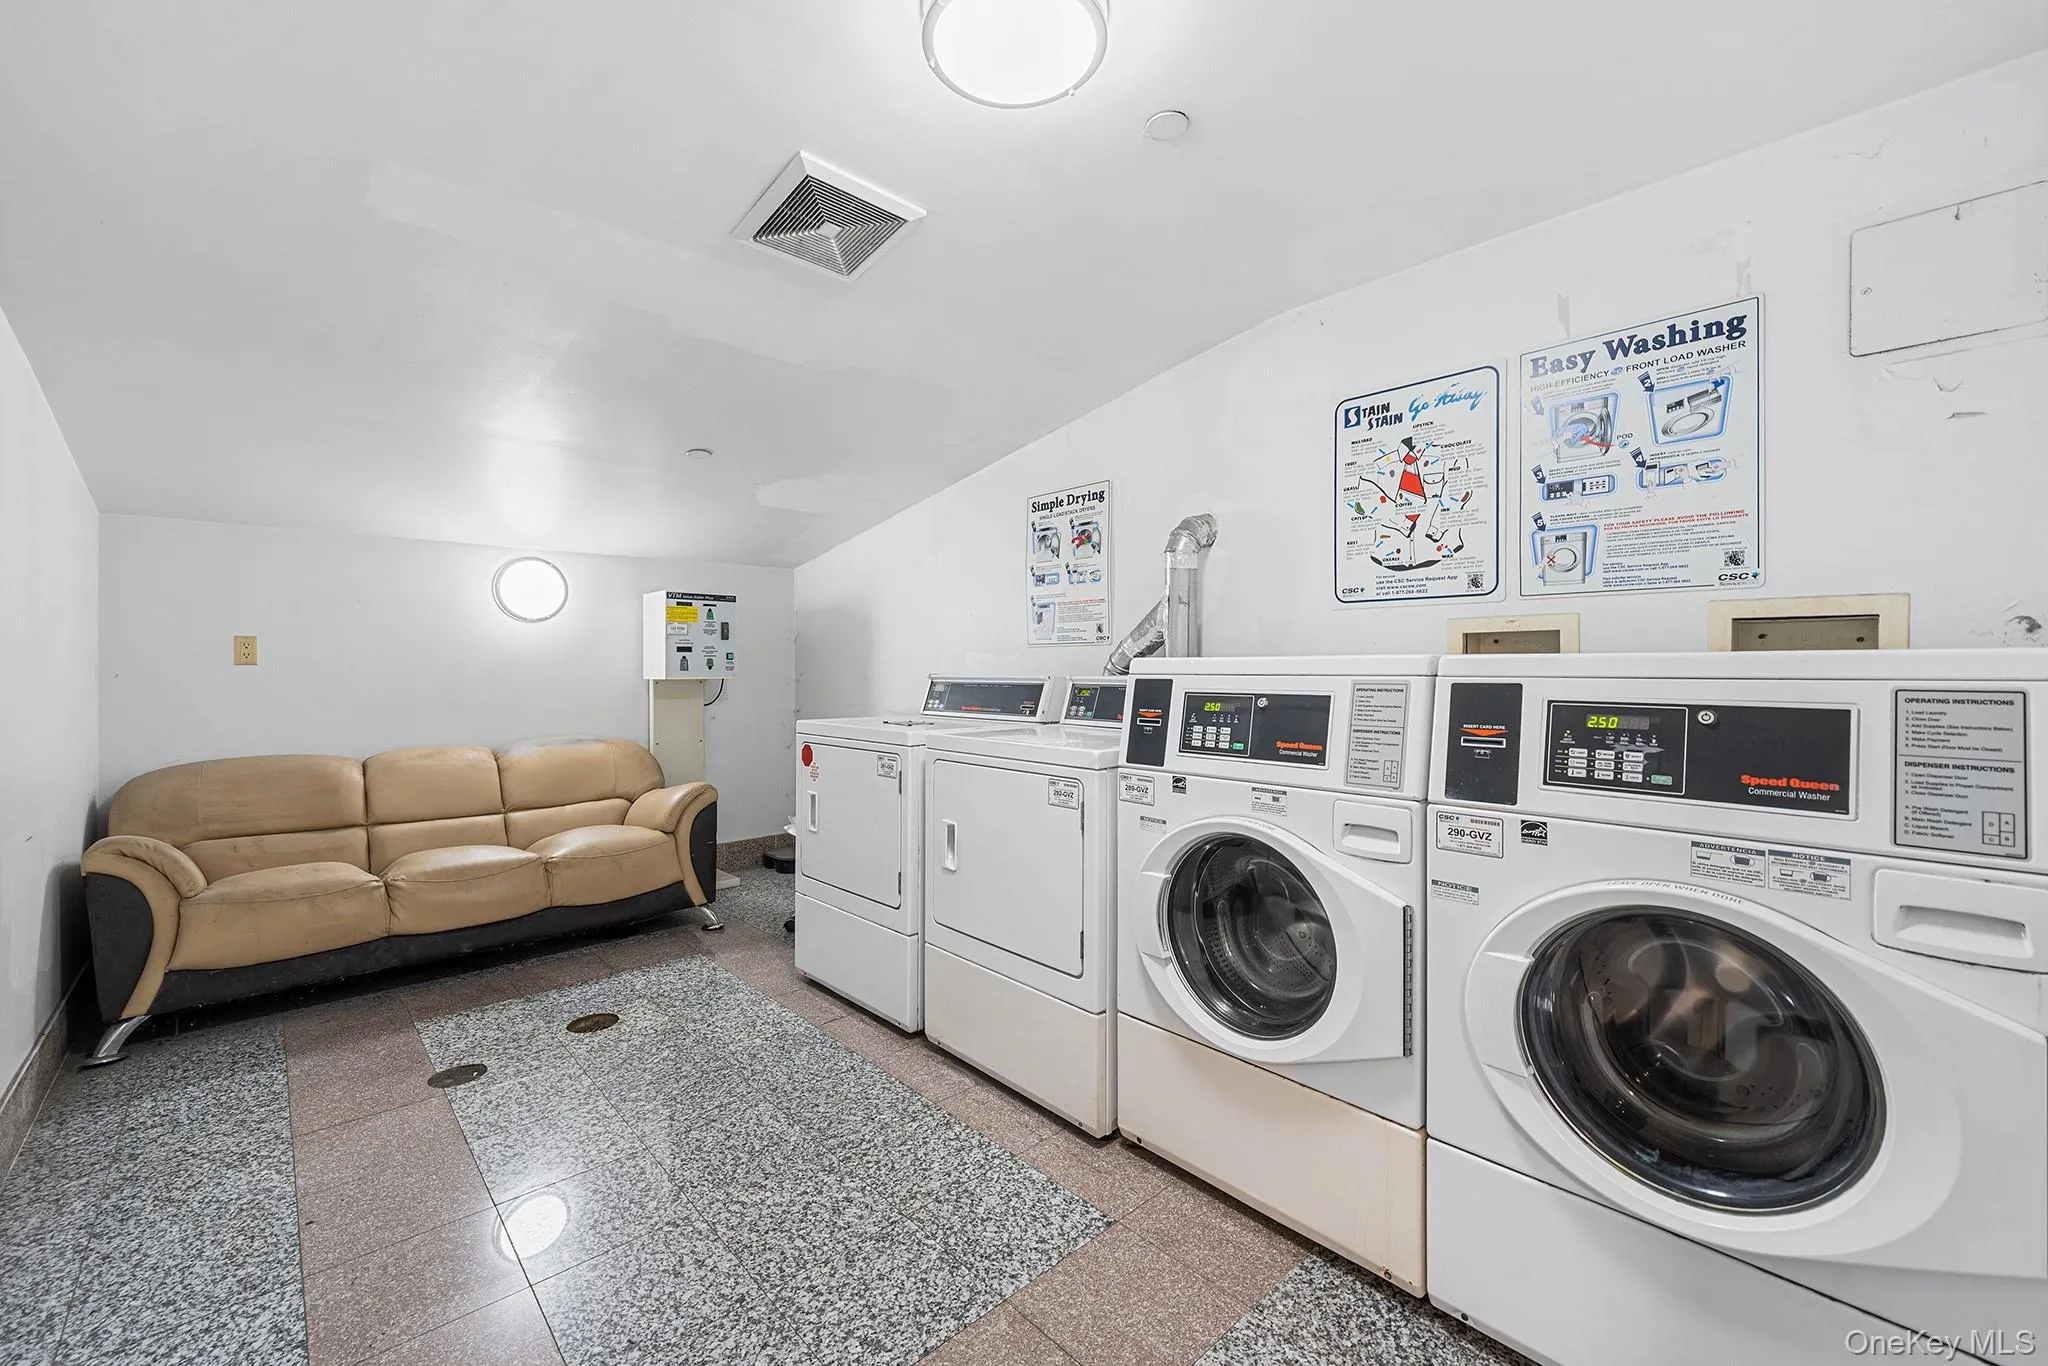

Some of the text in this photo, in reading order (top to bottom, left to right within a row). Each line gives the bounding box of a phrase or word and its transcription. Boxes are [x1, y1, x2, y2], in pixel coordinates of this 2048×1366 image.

[1530, 314, 1747, 378] Easy Washing
[1530, 370, 1609, 393] HIGH-EFFICIENCY
[1626, 359, 1661, 373] FRONT
[1663, 352, 1694, 364] LOAD
[1697, 340, 1746, 357] WASHER
[1408, 395, 1430, 422] Go
[1434, 384, 1484, 411] Away
[1368, 413, 1403, 431] STAIN
[1441, 440, 1472, 449] CHOCOLATE
[1032, 490, 1106, 513] Simple Drying
[1718, 572, 1750, 581] CSC
[1587, 716, 1618, 729] 2.50
[1276, 741, 1323, 751] Speed Queen
[1905, 761, 2015, 774] DISPENSER INSTRUCTIONS
[1125, 784, 1149, 794] 289-GVZ
[1741, 774, 1840, 791] Speed Queen
[1748, 786, 1831, 801] Commercial Washer
[1448, 827, 1492, 841] 290-GVZ
[1700, 842, 1757, 854] ADVERTENCIA
[1792, 853, 1826, 862] NOTICE
[1674, 885, 1708, 895] WHEN
[1712, 892, 1745, 904] DONE
